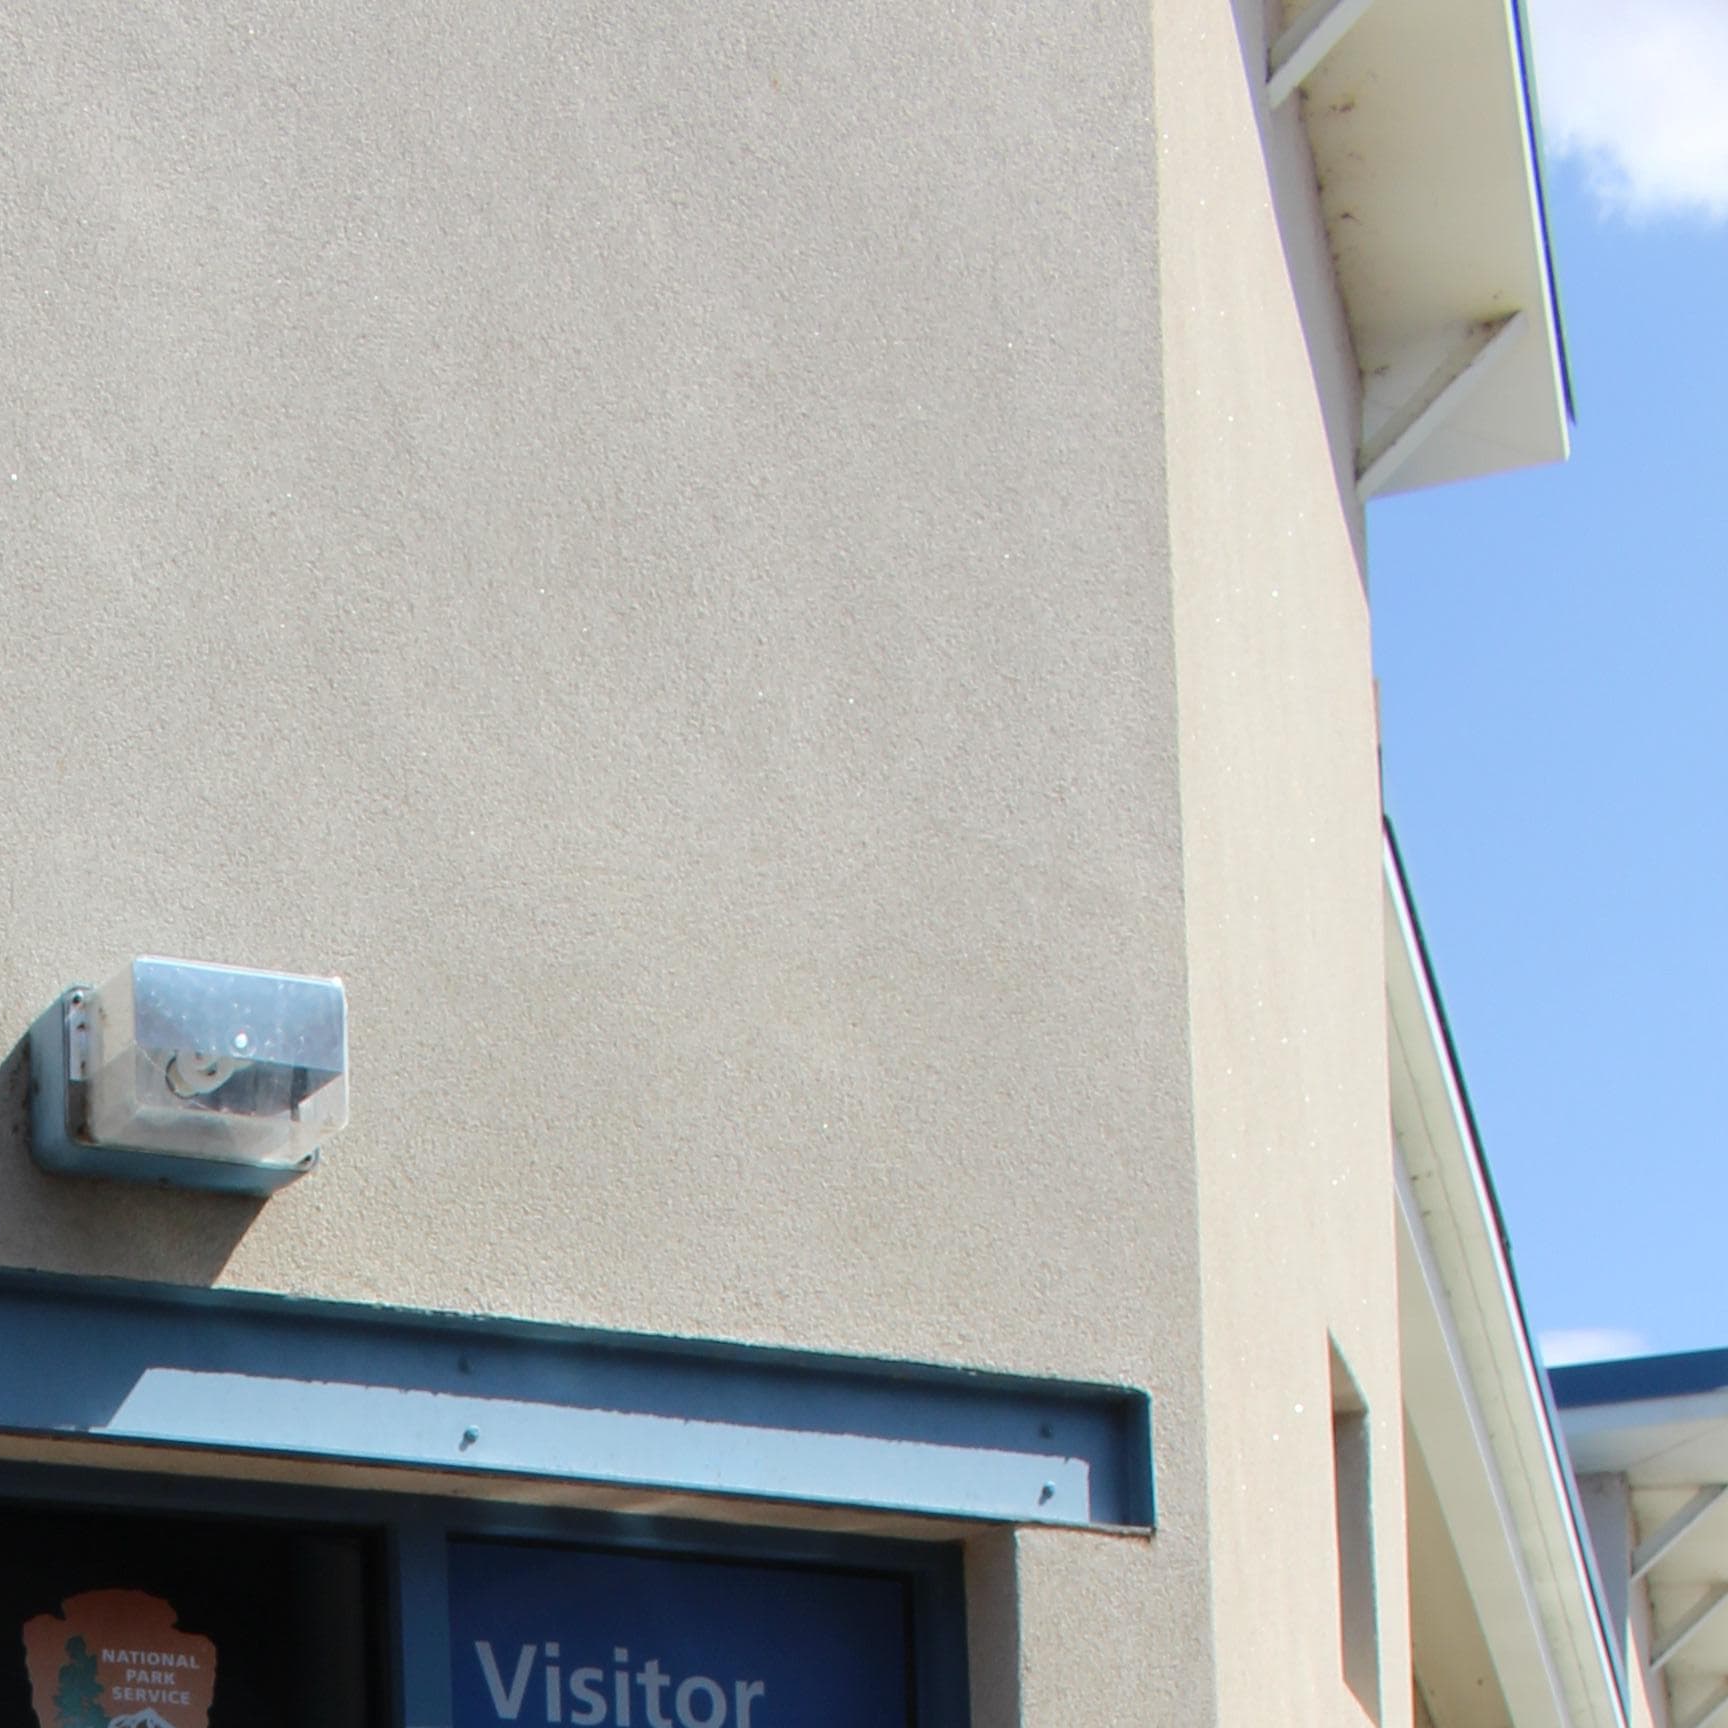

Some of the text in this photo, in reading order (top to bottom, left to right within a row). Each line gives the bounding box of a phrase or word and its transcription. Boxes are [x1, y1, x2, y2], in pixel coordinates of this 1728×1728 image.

[101, 1648, 200, 1669] NATIONAL
[126, 1668, 176, 1685] PARK
[112, 1685, 191, 1705] SERVICE
